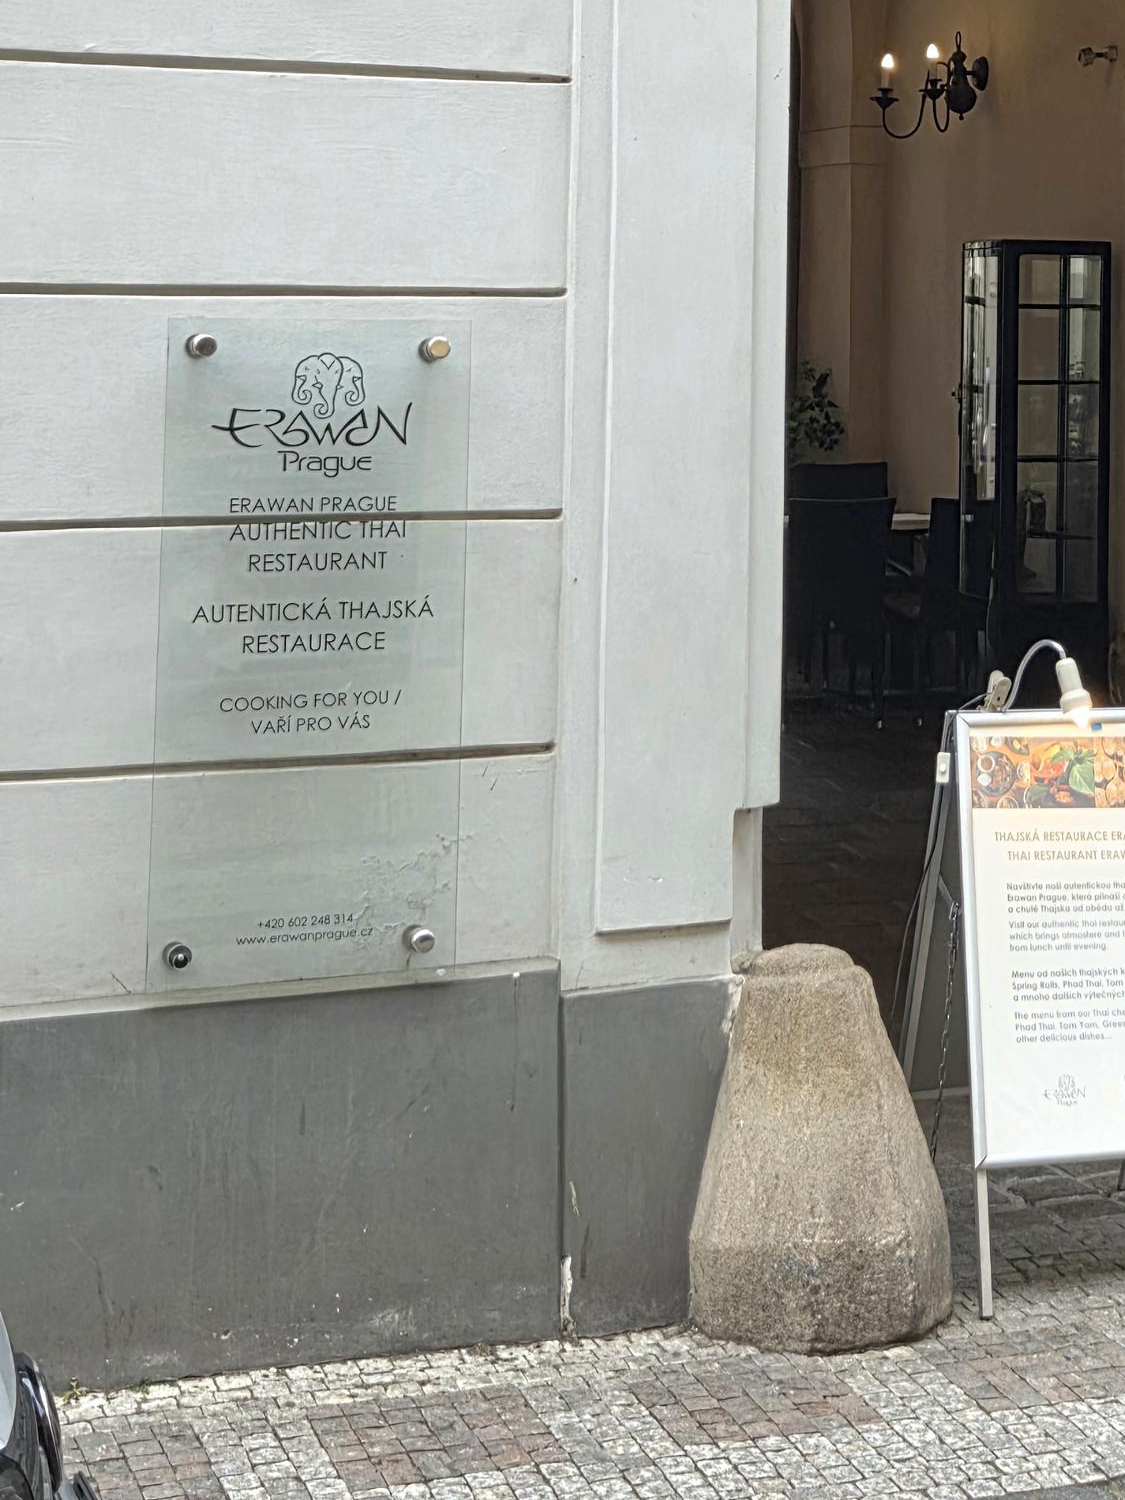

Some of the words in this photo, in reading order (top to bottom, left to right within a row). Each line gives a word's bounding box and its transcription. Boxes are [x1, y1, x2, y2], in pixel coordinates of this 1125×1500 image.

[278, 451, 372, 477] Prague
[229, 497, 313, 513] ERAWAN
[321, 495, 397, 512] PRAGUE
[229, 520, 351, 541] AUTHENTIC
[359, 520, 407, 538] THAI
[249, 551, 387, 572] RESTAURANT
[193, 597, 332, 623] AUTENTICKÁ
[339, 595, 434, 620] THAJSKÁ
[242, 631, 386, 654] RESTAURACE
[220, 693, 308, 713] COOKING
[314, 692, 348, 708] FOR
[353, 690, 390, 707] YOU
[251, 715, 291, 734] VAŘÍ
[296, 716, 332, 732] PRO
[338, 712, 370, 730] VÁS
[995, 829, 1040, 841] THAJSKÁ
[1044, 831, 1108, 841] RESTAURACE
[1007, 851, 1030, 861] THAI
[1034, 850, 1098, 860] RESTAURANT
[257, 917, 285, 929] +420
[288, 916, 308, 928] 602
[311, 914, 331, 926] 248
[333, 913, 354, 925] 314
[1009, 920, 1024, 928] Visit
[1042, 919, 1079, 928] authentic
[236, 926, 373, 946] www.erawanprague.cz
[1009, 932, 1033, 940] which
[1035, 931, 1059, 941] brings
[1105, 929, 1120, 938] and
[1010, 943, 1028, 952] from
[1030, 943, 1053, 951] lunch
[1012, 981, 1037, 992] Spring
[1063, 980, 1083, 988] Phad
[1106, 978, 1123, 987] Tom
[1015, 1011, 1028, 1020] The
[1056, 1010, 1075, 1018] from
[1078, 1010, 1089, 1018] our
[1092, 1009, 1109, 1017] Thai
[1015, 1022, 1036, 1031] Phad
[1059, 1020, 1077, 1029] Tom
[1016, 1035, 1037, 1043] other
[1040, 1033, 1077, 1042] delicious
